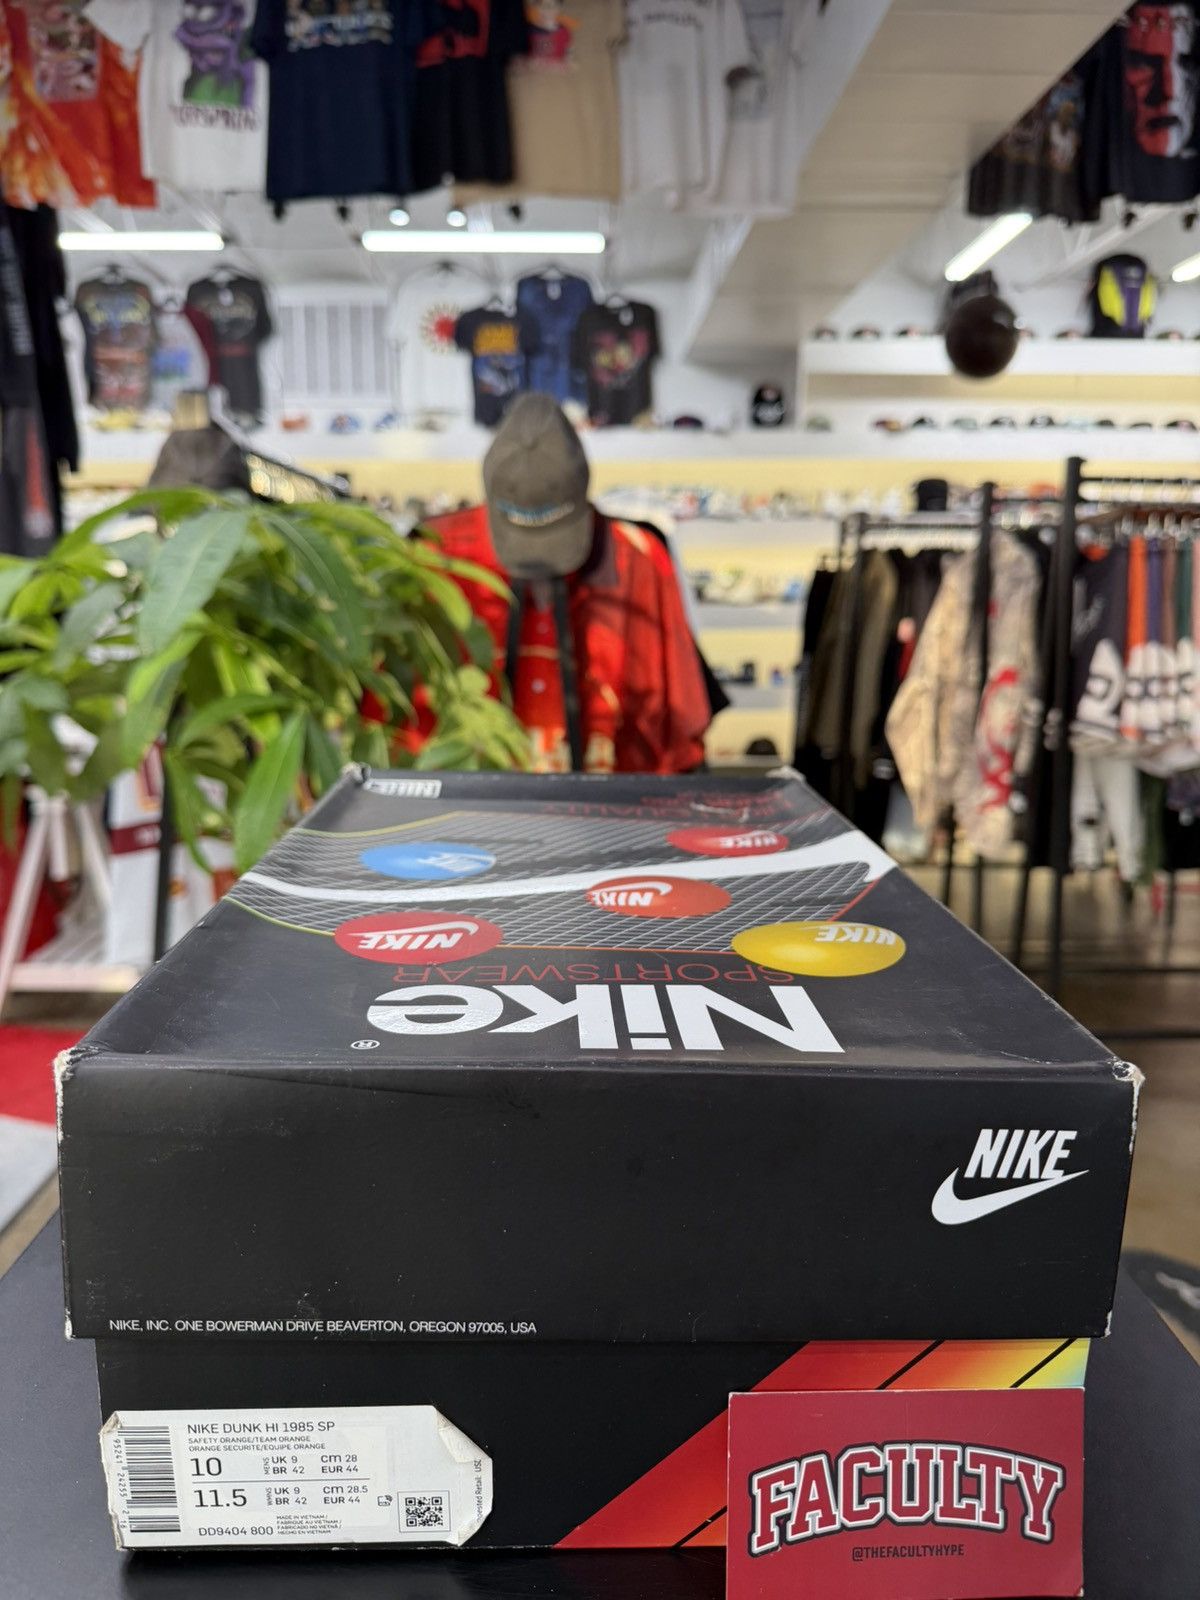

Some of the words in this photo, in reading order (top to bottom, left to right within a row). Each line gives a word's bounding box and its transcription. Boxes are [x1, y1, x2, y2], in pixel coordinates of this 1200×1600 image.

[592, 890, 654, 906] NIKE
[358, 932, 464, 950] NIKE
[814, 925, 897, 945] NIKE
[393, 964, 795, 983] SPORTSWEAR
[367, 984, 846, 1053] Nike
[963, 1128, 1078, 1180] NIKE
[109, 1320, 143, 1331] NIKE,
[146, 1320, 172, 1331] INC.
[175, 1320, 203, 1331] ONE
[206, 1320, 284, 1331] BOWERMAN
[286, 1320, 324, 1331] DRIVE
[326, 1320, 407, 1333] BEAVERTON,
[409, 1321, 466, 1333] OREGON
[468, 1322, 508, 1334] 97005,
[510, 1322, 537, 1333] USA
[187, 1423, 219, 1434] NIKE
[223, 1422, 262, 1433] DUNK
[265, 1422, 279, 1433] HI
[282, 1422, 314, 1433] 1985
[317, 1421, 336, 1432] SP
[219, 1436, 276, 1444] ORANGE/TEAM
[278, 1435, 311, 1443] ORANGE
[113, 1438, 123, 1464] 95241
[320, 1454, 342, 1463] cm
[345, 1454, 358, 1463] 28
[189, 1457, 223, 1476] 10
[262, 1456, 270, 1475] MENS
[271, 1455, 287, 1464] UK
[290, 1455, 298, 1464] 9
[272, 1466, 288, 1475] BR
[292, 1465, 305, 1475] 42
[321, 1465, 343, 1474] EUR
[345, 1464, 359, 1473] 44
[274, 1487, 290, 1495] UK
[293, 1487, 300, 1495] 9
[322, 1485, 344, 1494] cm
[347, 1485, 369, 1494] 28.5
[194, 1489, 247, 1508] 11.5
[275, 1497, 290, 1506] BR
[294, 1496, 308, 1505] 42
[323, 1497, 346, 1505] EUR
[347, 1496, 361, 1505] 44
[750, 1440, 1066, 1557] FACULTY
[198, 1527, 247, 1536] DD9404
[250, 1526, 274, 1536] 800
[852, 1544, 965, 1562] @THEFACULTYHYPE
